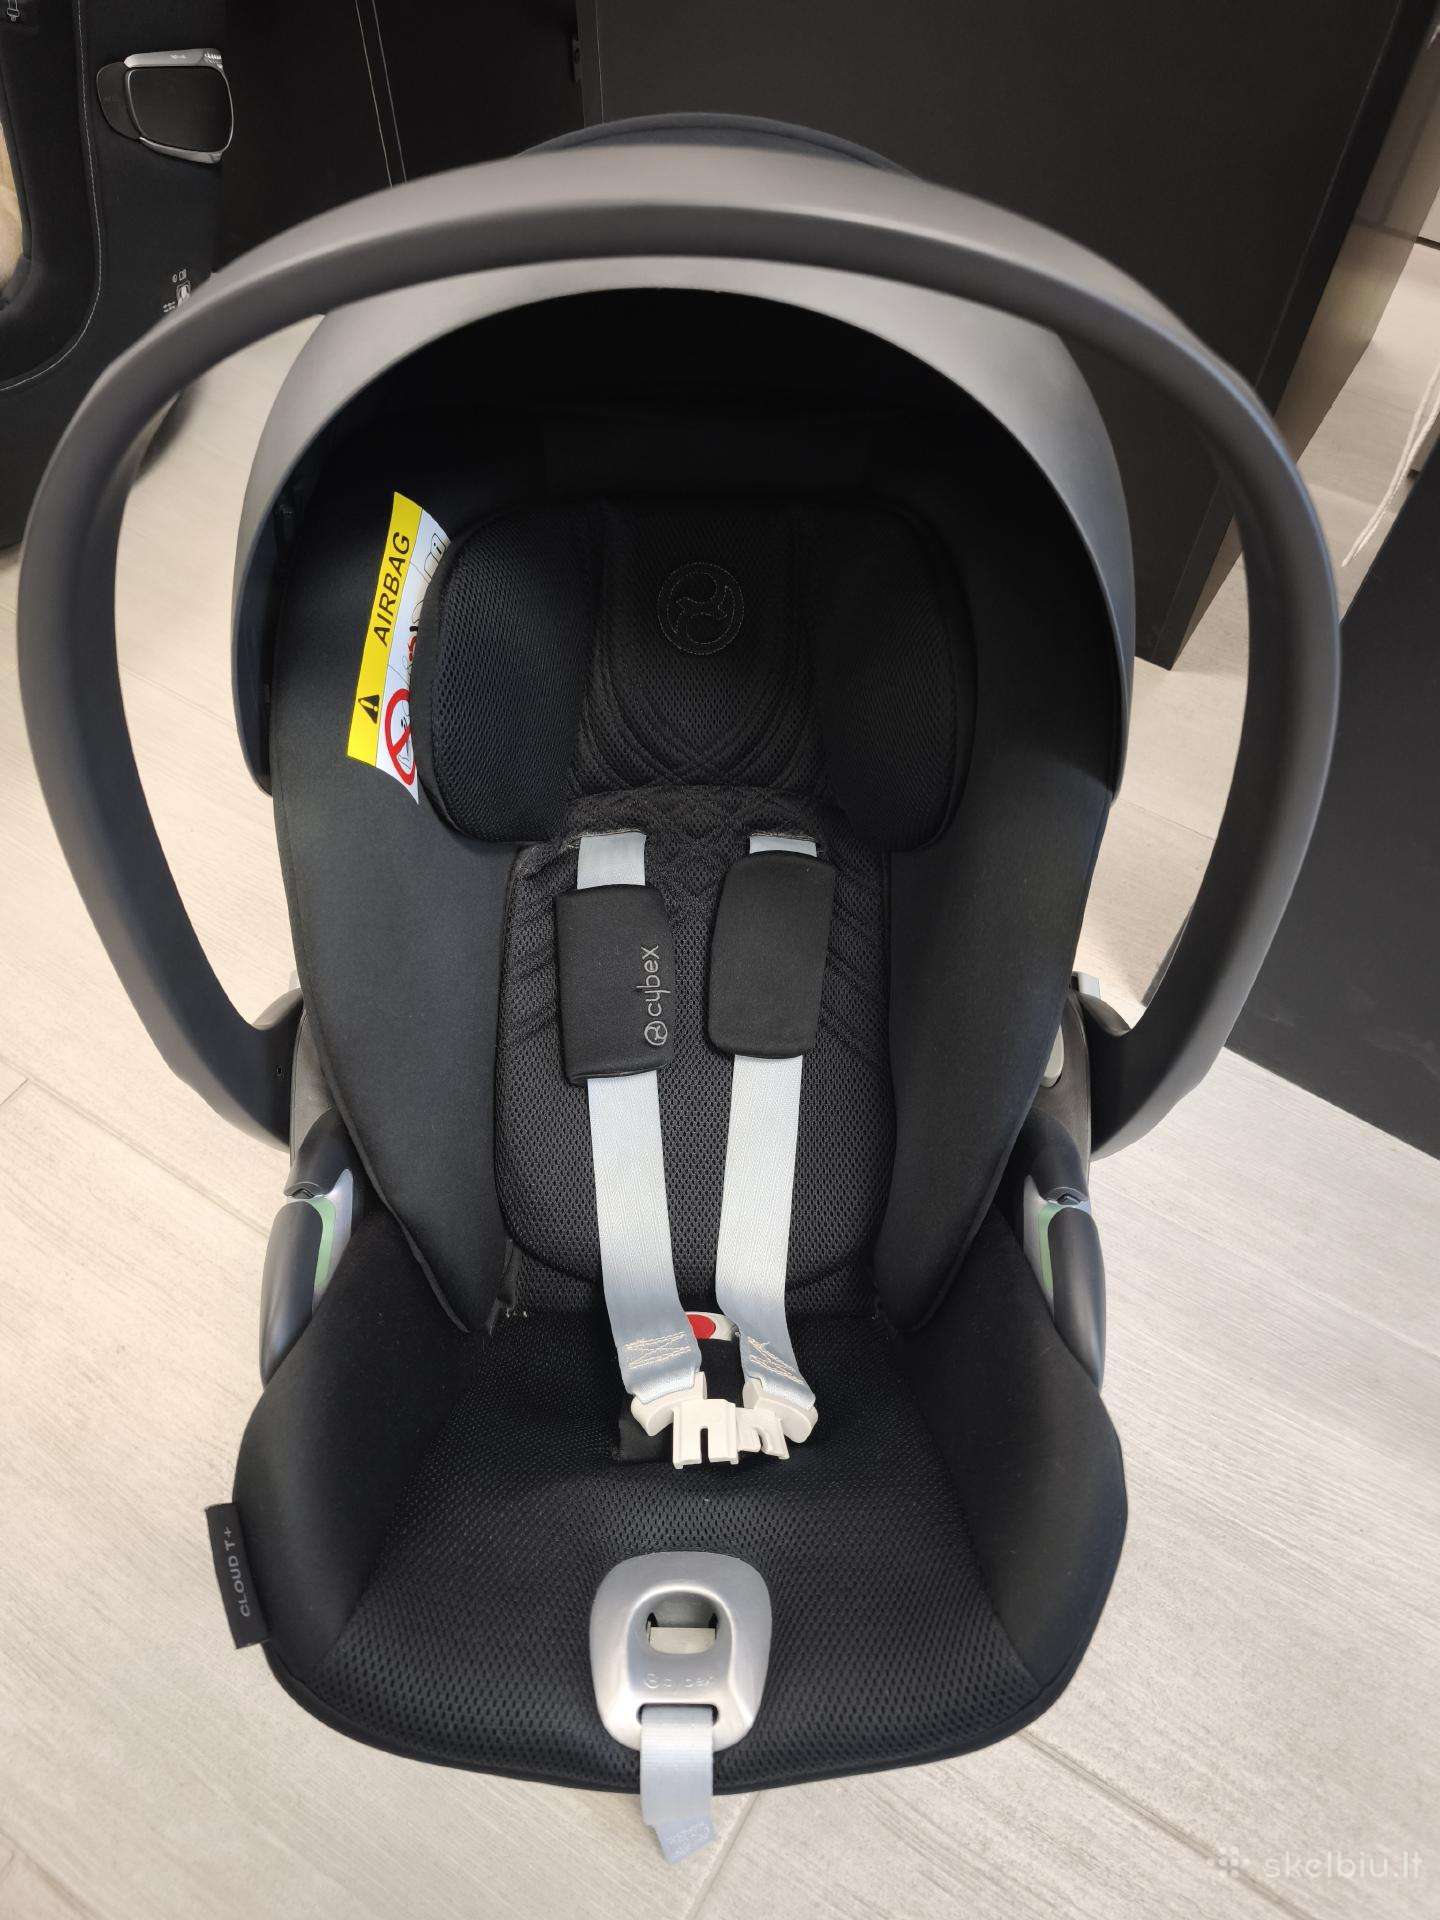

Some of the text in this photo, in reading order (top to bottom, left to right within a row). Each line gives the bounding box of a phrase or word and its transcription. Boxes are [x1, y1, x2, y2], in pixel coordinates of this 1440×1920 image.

[373, 531, 410, 647] AIRBAG
[636, 944, 671, 1017] cybex
[224, 1526, 250, 1617] CLOUD T+
